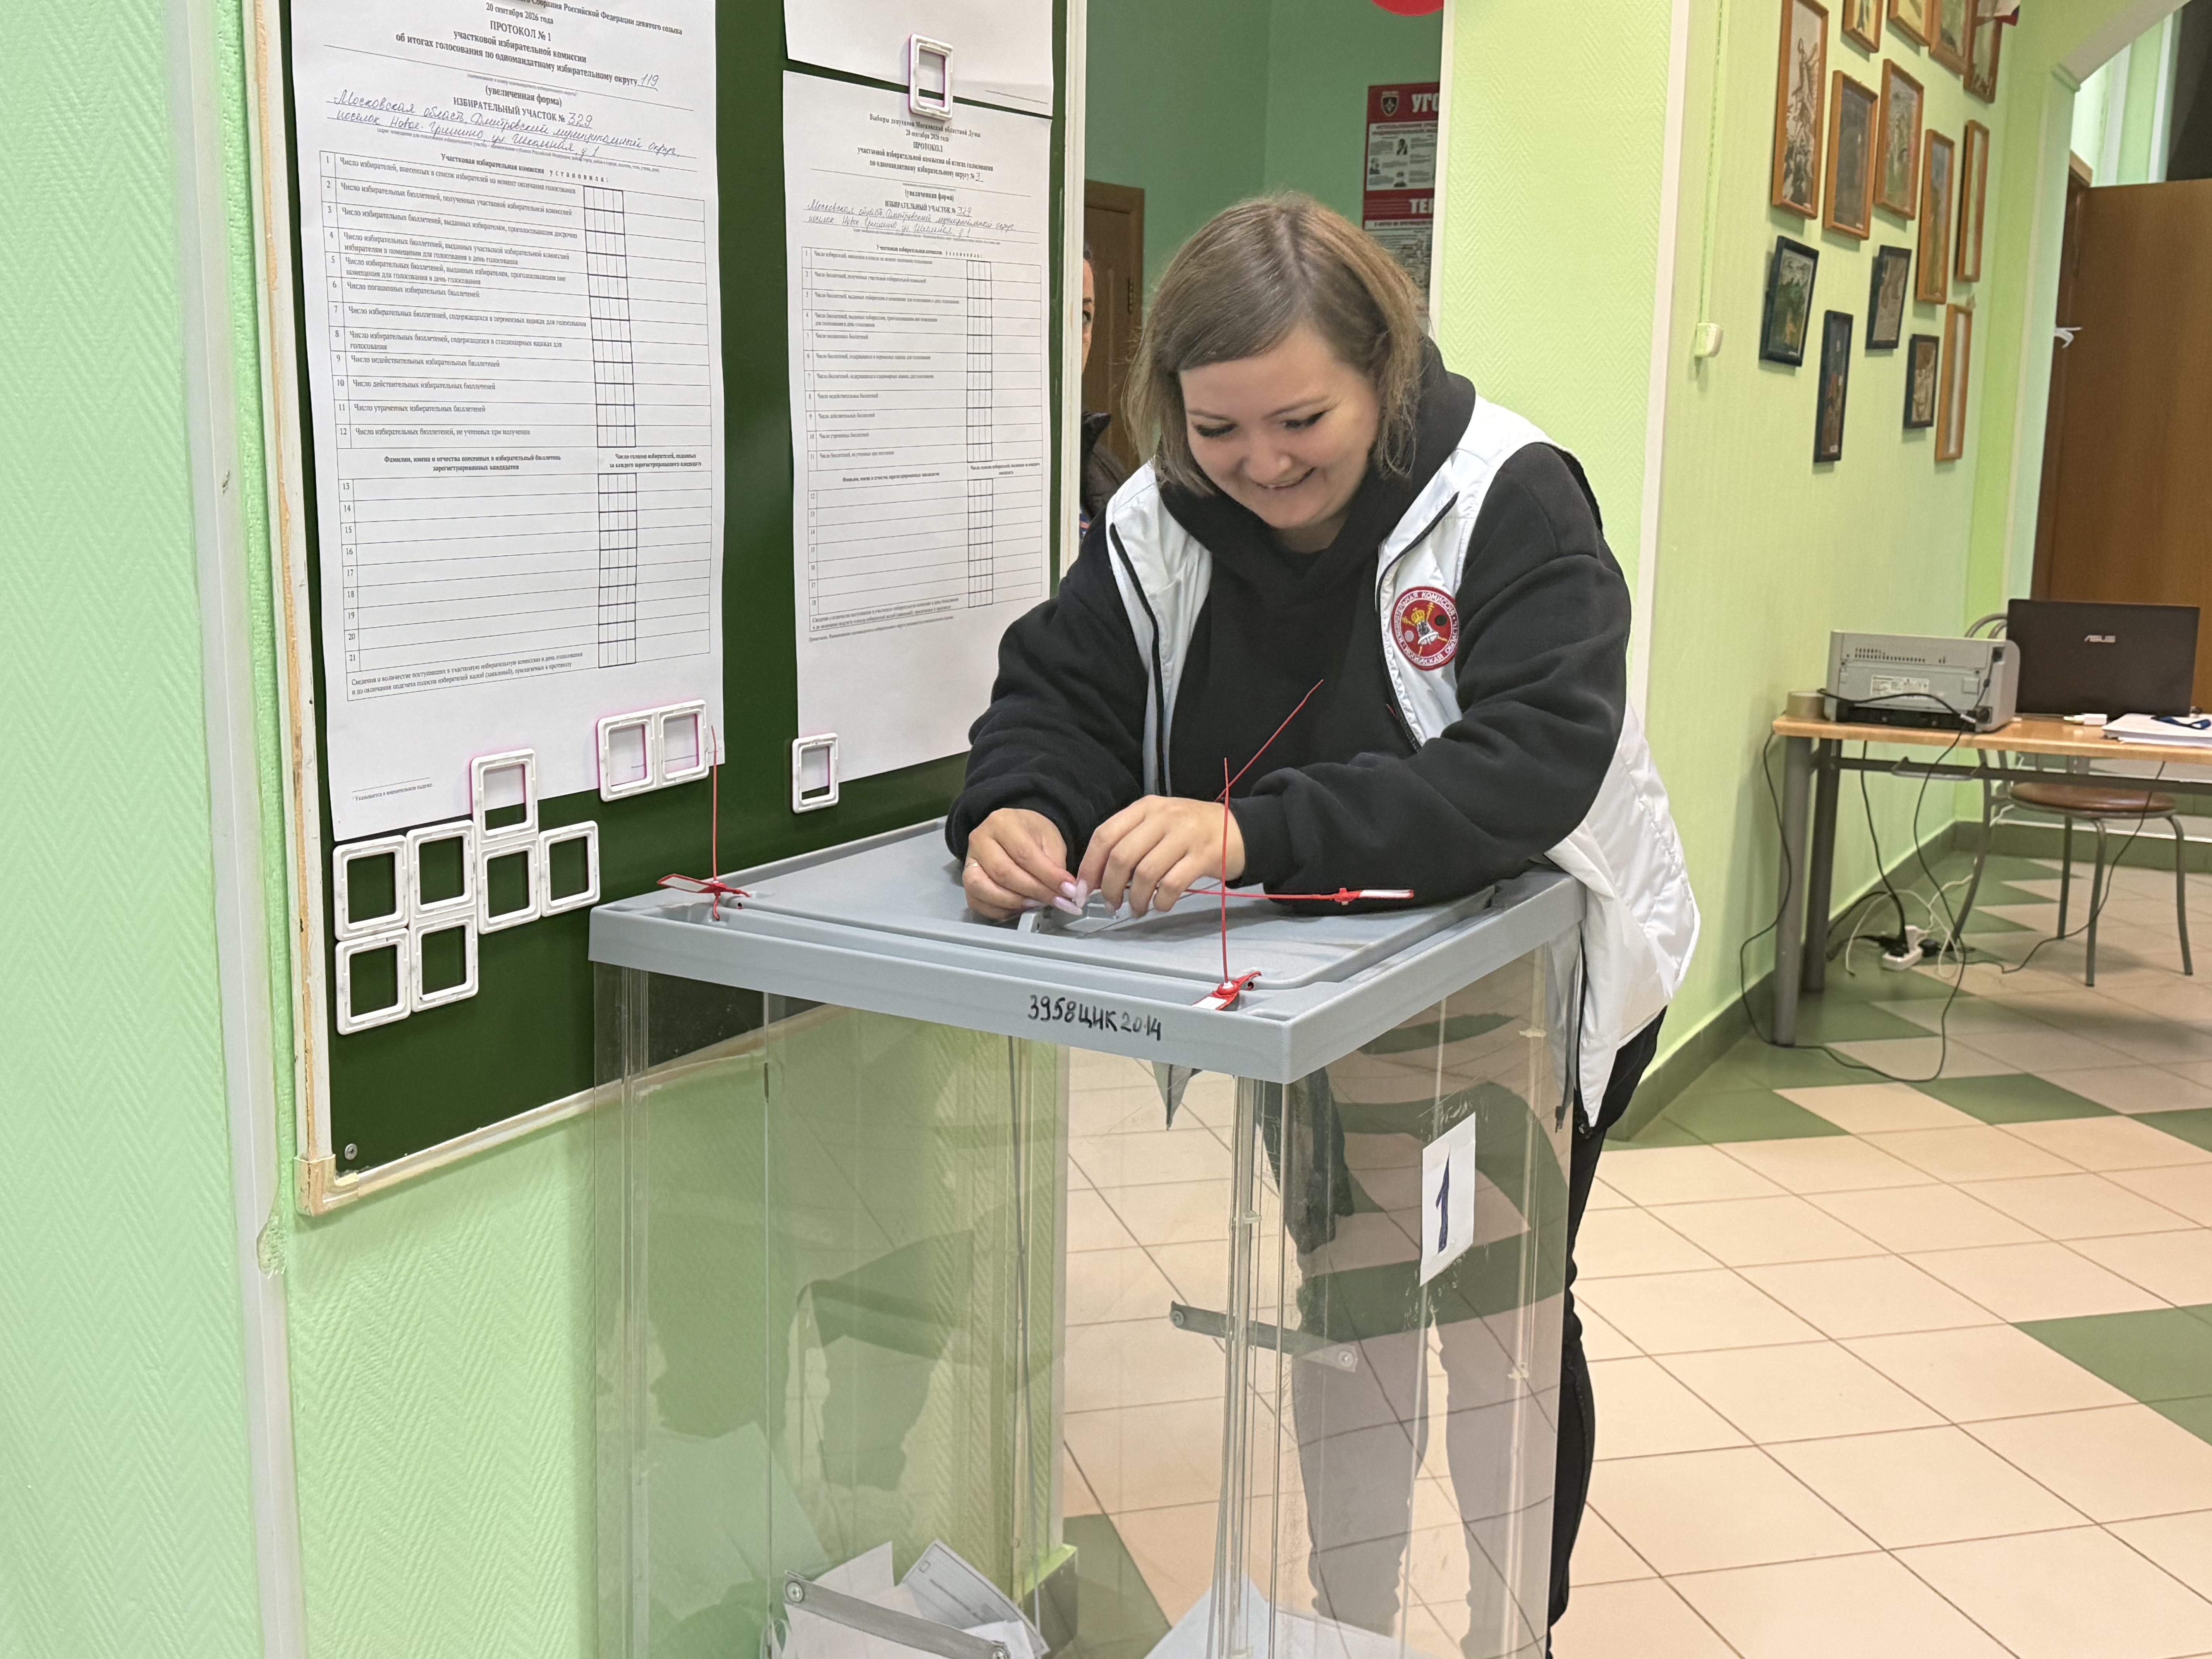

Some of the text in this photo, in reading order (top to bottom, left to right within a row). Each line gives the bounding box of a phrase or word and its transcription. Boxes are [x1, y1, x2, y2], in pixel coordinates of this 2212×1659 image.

[486, 2, 554, 25] 20 сентября 2026 года
[563, 3, 599, 18] Российской
[600, 11, 635, 26] Федерации
[635, 20, 661, 31] девятого
[662, 26, 683, 35] созыва
[490, 20, 551, 42] ПРОТОКОЛ № 1
[453, 31, 587, 64] участковой избирательной комиссии
[395, 33, 659, 87] об итогах голосования по одномандатному избирательному округу 119
[485, 84, 535, 101] (увеличенная
[536, 93, 562, 108] форма)
[334, 89, 416, 113] Московская
[453, 96, 593, 127] ИЗБИРАТЕЛЬНЫЙ УЧАСТОК № 329
[326, 155, 329, 164] 1
[440, 153, 475, 165] Участковая
[476, 159, 518, 170] избирательная
[518, 165, 544, 174] комиссия
[340, 156, 359, 167] Число
[360, 160, 398, 173] избирателей,
[455, 173, 489, 183] избирателей
[326, 180, 331, 189] 2
[340, 182, 361, 192] Число
[361, 185, 406, 197] избирательных
[406, 189, 442, 202] бюллетеней,
[327, 205, 332, 214] 3
[342, 207, 361, 216] Число
[362, 210, 407, 221] избирательных
[408, 214, 443, 226] бюллетеней,
[344, 244, 383, 254] избирателям
[331, 255, 335, 264] 5
[332, 280, 337, 289] 6
[347, 281, 366, 290] Число
[404, 286, 447, 296] избирательных
[447, 289, 480, 298] бюллетеней
[334, 305, 338, 313] 7
[335, 330, 340, 338] 8
[336, 354, 341, 362] 9
[351, 355, 371, 363] Число
[352, 379, 372, 387] Число
[372, 380, 419, 388] действительных
[409, 404, 452, 413] избирательных
[343, 482, 350, 491] 13
[343, 504, 351, 512] 14
[345, 526, 352, 534] 15
[347, 568, 354, 577] 17
[1422, 592, 1455, 616] КОМИССИЯ
[348, 611, 355, 619] 19
[347, 632, 356, 641] 20
[2084, 635, 2116, 643] ASUS
[1436, 1144, 1452, 1255] 1
